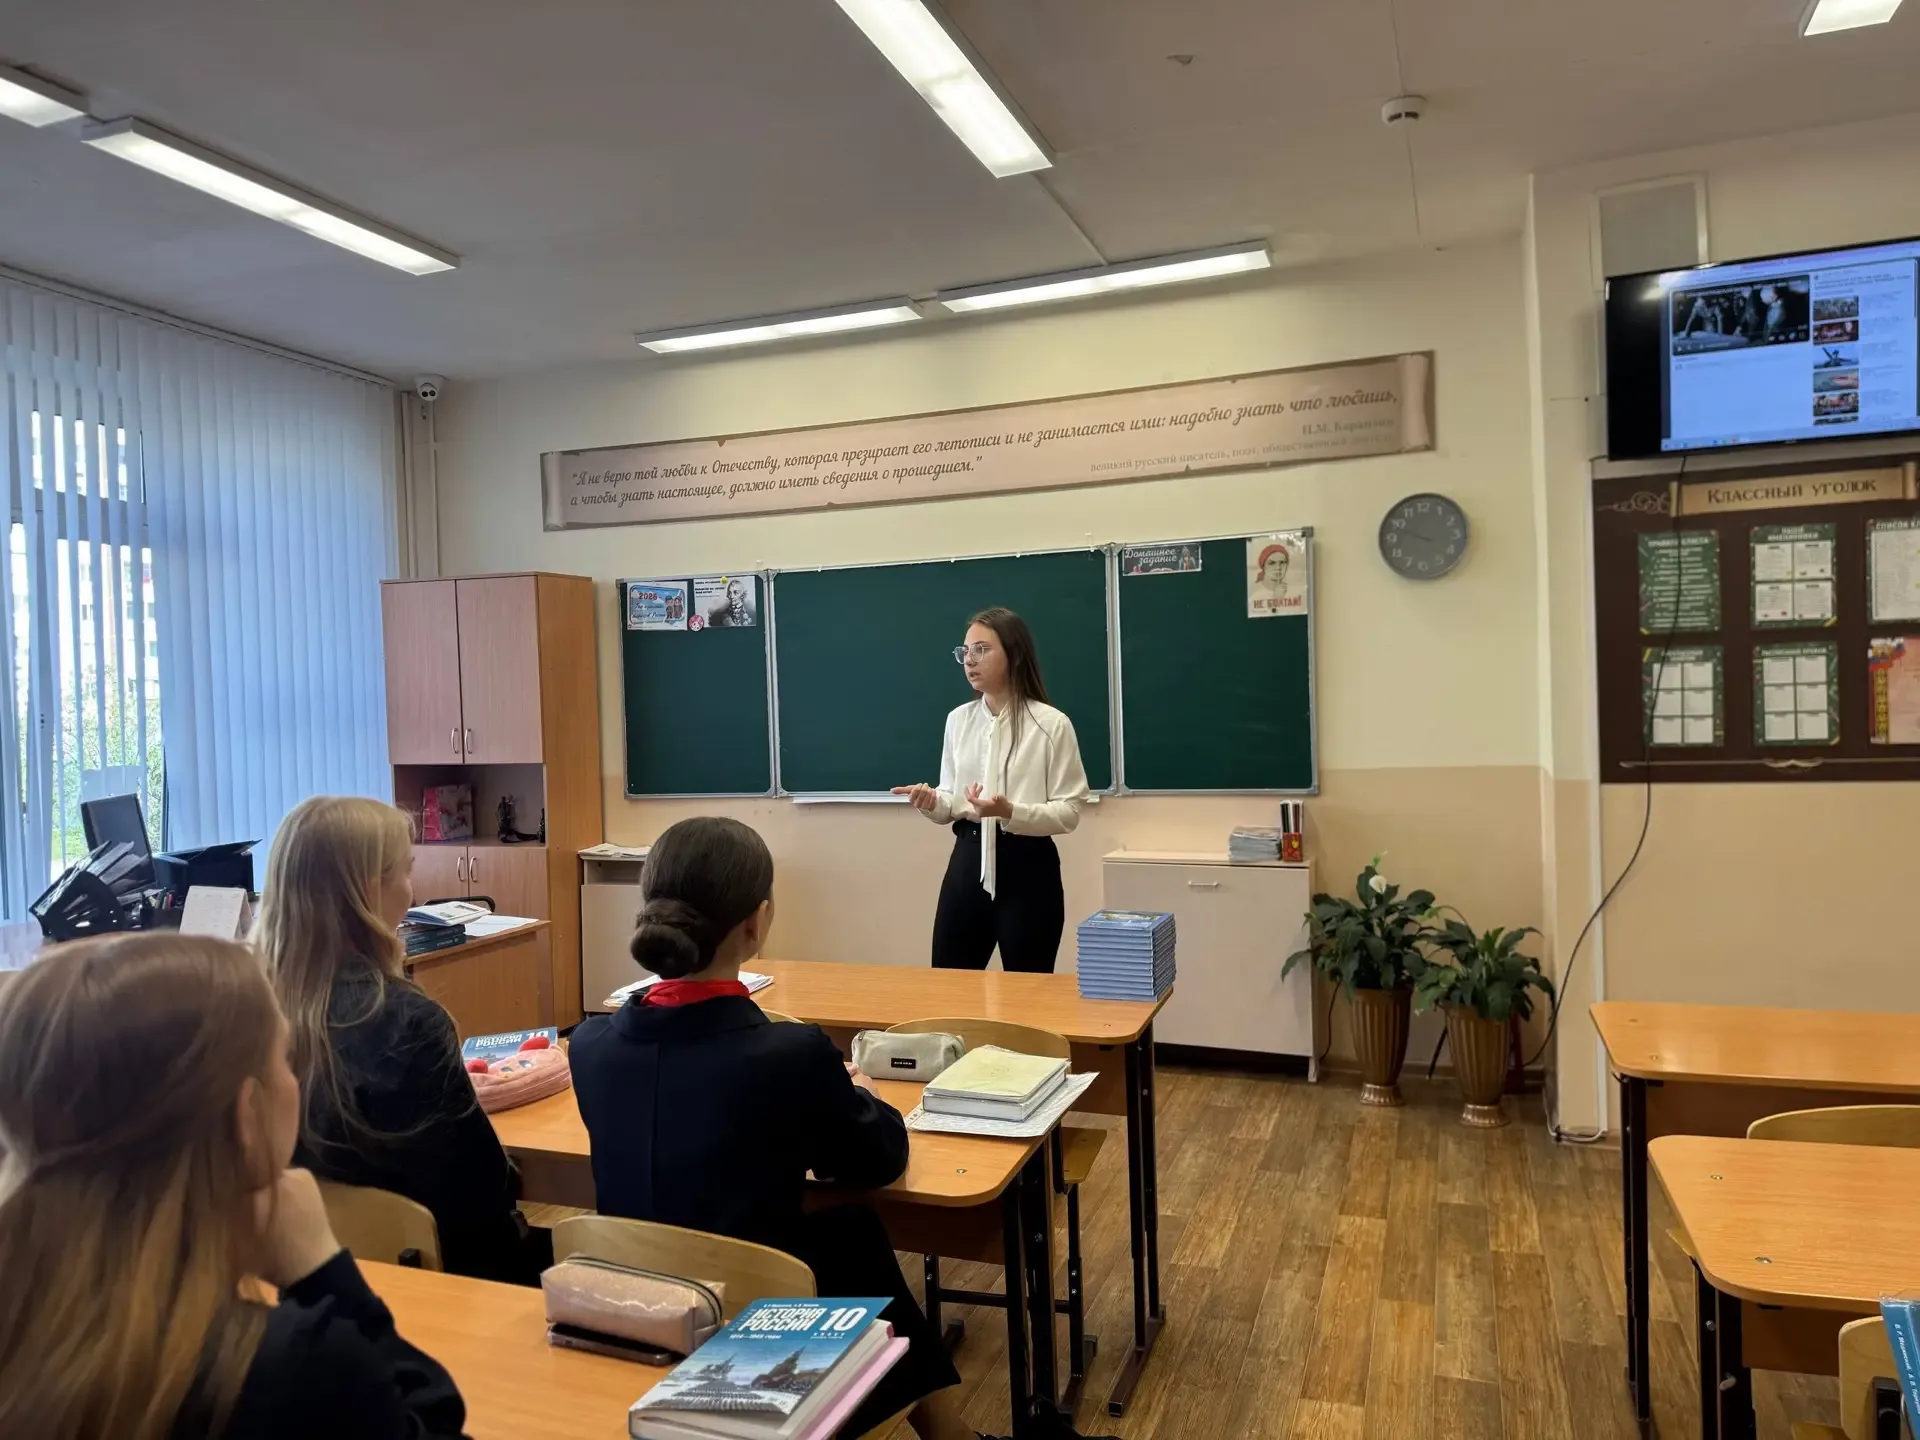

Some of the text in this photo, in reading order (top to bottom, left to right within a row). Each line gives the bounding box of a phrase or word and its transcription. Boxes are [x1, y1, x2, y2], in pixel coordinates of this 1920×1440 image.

[588, 473, 601, 484] не
[603, 470, 632, 488] верю
[634, 466, 658, 481] той
[661, 463, 697, 478] любви
[700, 464, 708, 475] к
[712, 456, 780, 475] Отечеству,
[784, 451, 838, 470] которая
[842, 444, 909, 468] презирает
[912, 442, 932, 454] его
[934, 433, 1001, 453] летописи
[1005, 434, 1014, 445] и
[1017, 431, 1033, 444] не
[1034, 421, 1125, 448] занимается
[1130, 416, 1166, 431] ими:
[1169, 406, 1232, 432] надобно
[1233, 404, 1284, 426] знать
[1289, 397, 1322, 412] что
[1134, 455, 1176, 469] русский
[570, 496, 578, 506] а
[581, 492, 617, 505] чтобы
[617, 491, 655, 508] знать
[657, 485, 726, 500] настоящее,
[728, 481, 776, 500] должно
[779, 475, 819, 489] иметь
[822, 470, 878, 490] сведения
[882, 469, 890, 480] о
[1125, 549, 1176, 558] Домашнее
[1138, 555, 1177, 567] задание
[752, 1308, 828, 1320] ИСТОРИЯ
[819, 1307, 868, 1331] 10
[738, 1318, 815, 1331] РОССИИ
